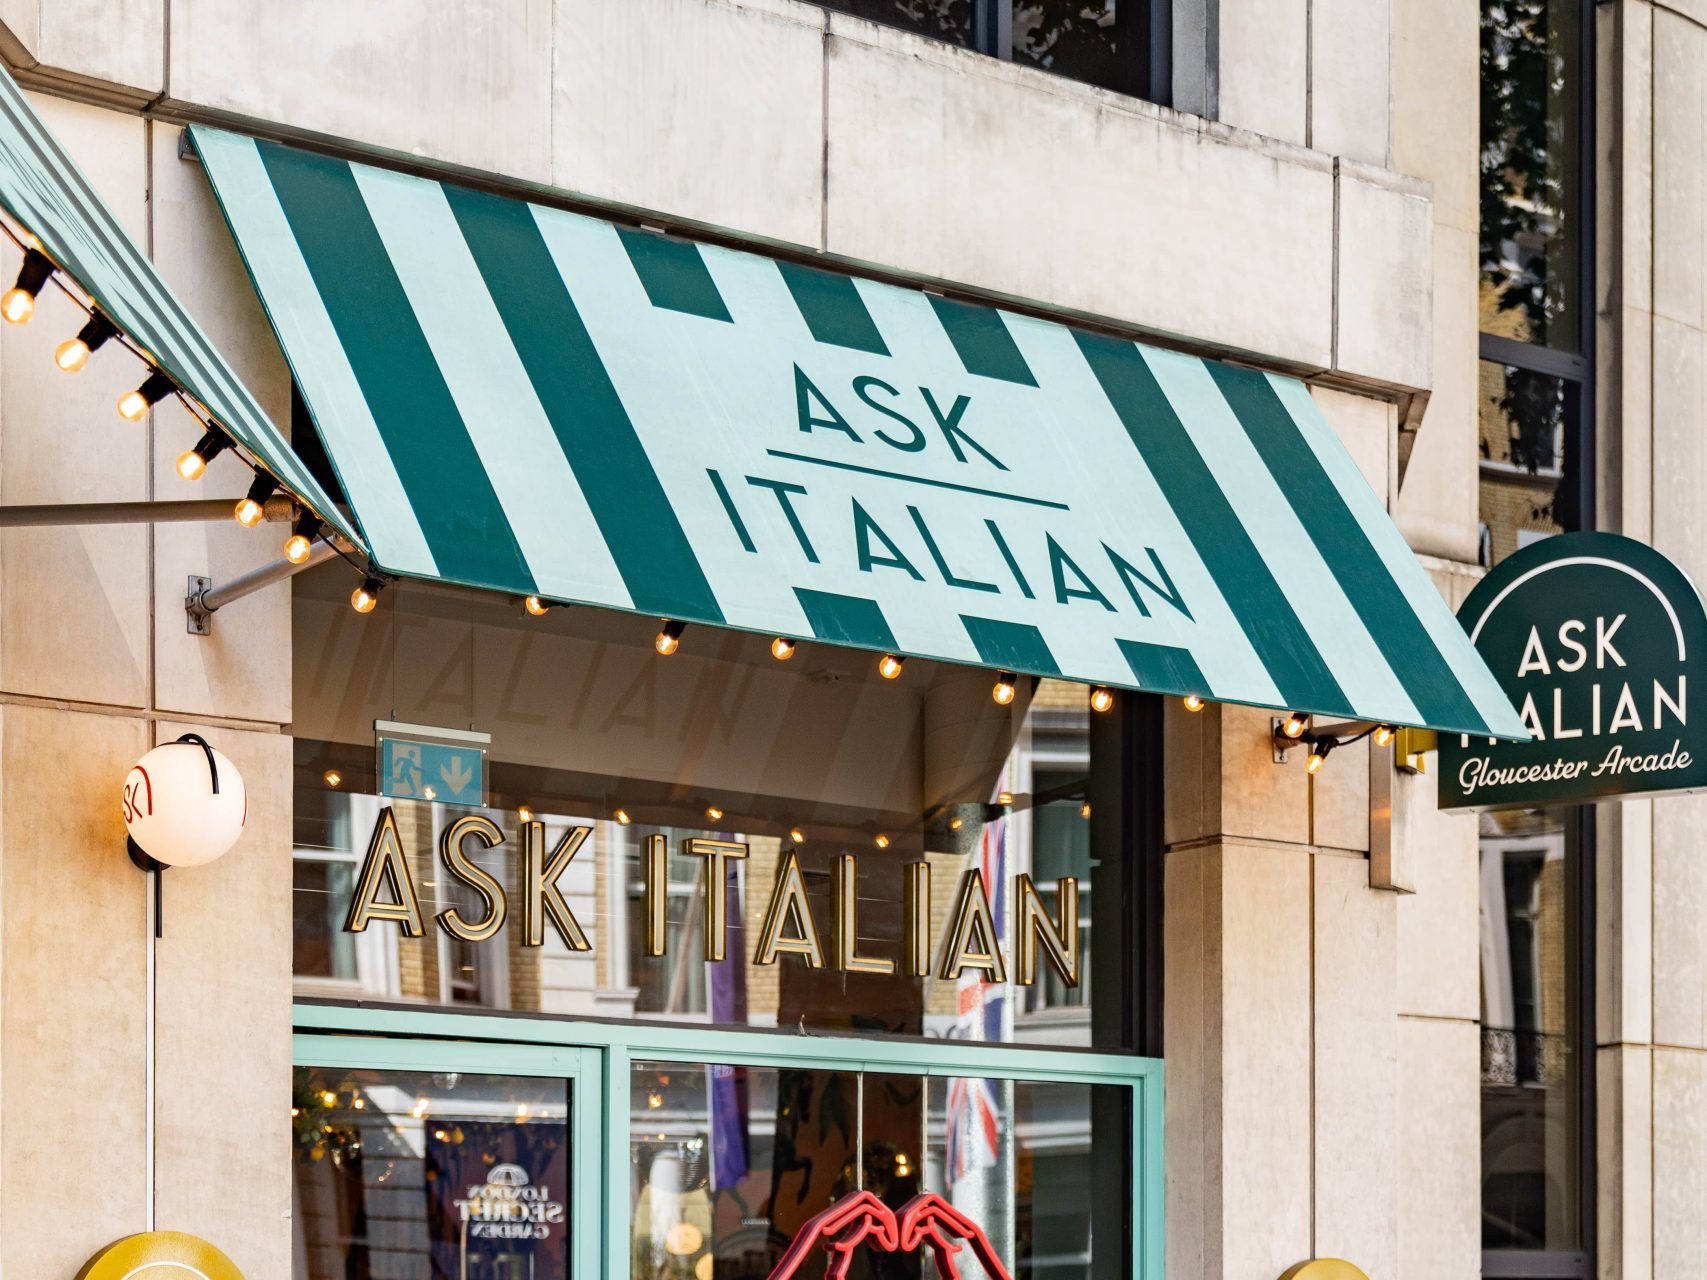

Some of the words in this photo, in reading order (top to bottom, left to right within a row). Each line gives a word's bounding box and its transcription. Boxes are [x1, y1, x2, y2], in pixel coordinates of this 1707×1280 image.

[793, 361, 1011, 471] ASK
[705, 467, 1196, 624] ITALIAN
[1517, 614, 1627, 677] ASK
[1461, 675, 1687, 748] ALIAN
[123, 782, 143, 824] SK
[1458, 757, 1588, 795] Gloucester
[1591, 739, 1693, 776] Arcade
[343, 805, 593, 951] ASK
[642, 832, 1079, 988] ITALIAN
